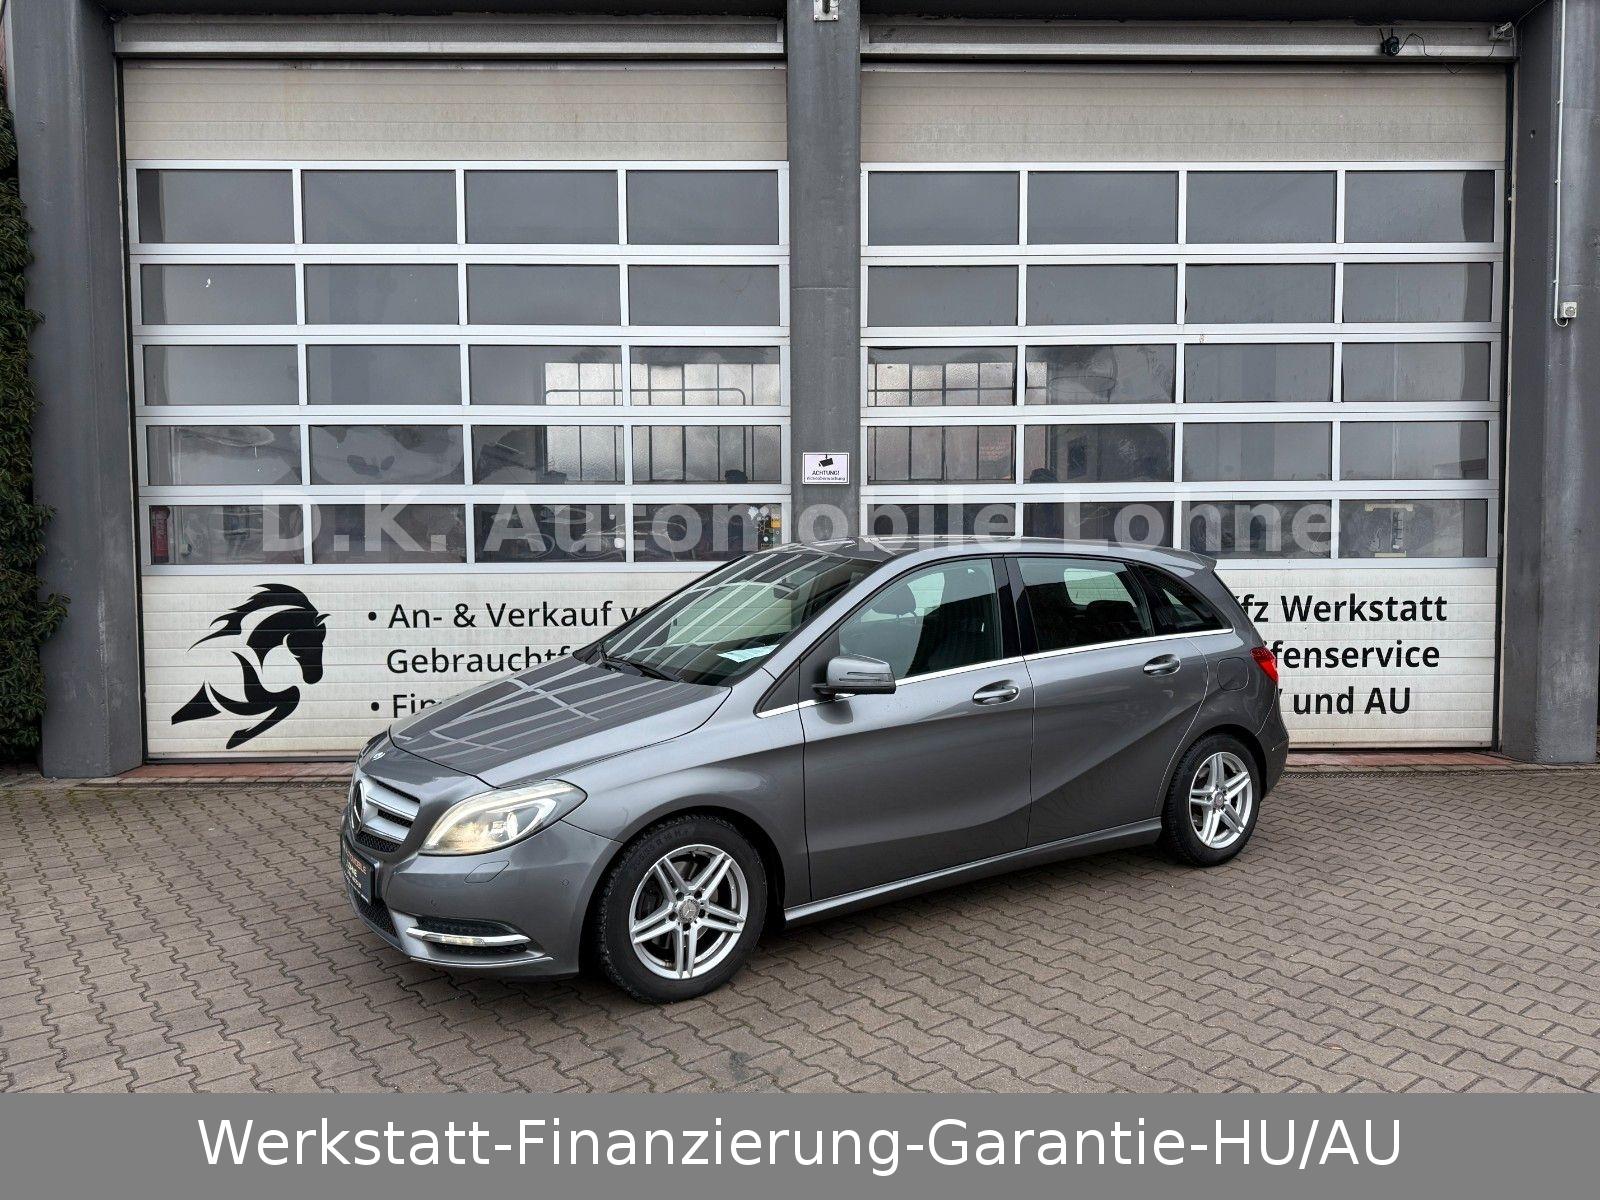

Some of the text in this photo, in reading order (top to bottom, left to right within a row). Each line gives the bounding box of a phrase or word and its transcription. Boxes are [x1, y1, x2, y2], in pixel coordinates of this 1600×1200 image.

[388, 603, 442, 629] An-
[453, 603, 477, 628] &
[486, 601, 613, 627] Verkauf
[1235, 593, 1448, 622] fz Werkstatt
[1264, 639, 1440, 669] fenservice
[1293, 686, 1411, 715] und AU
